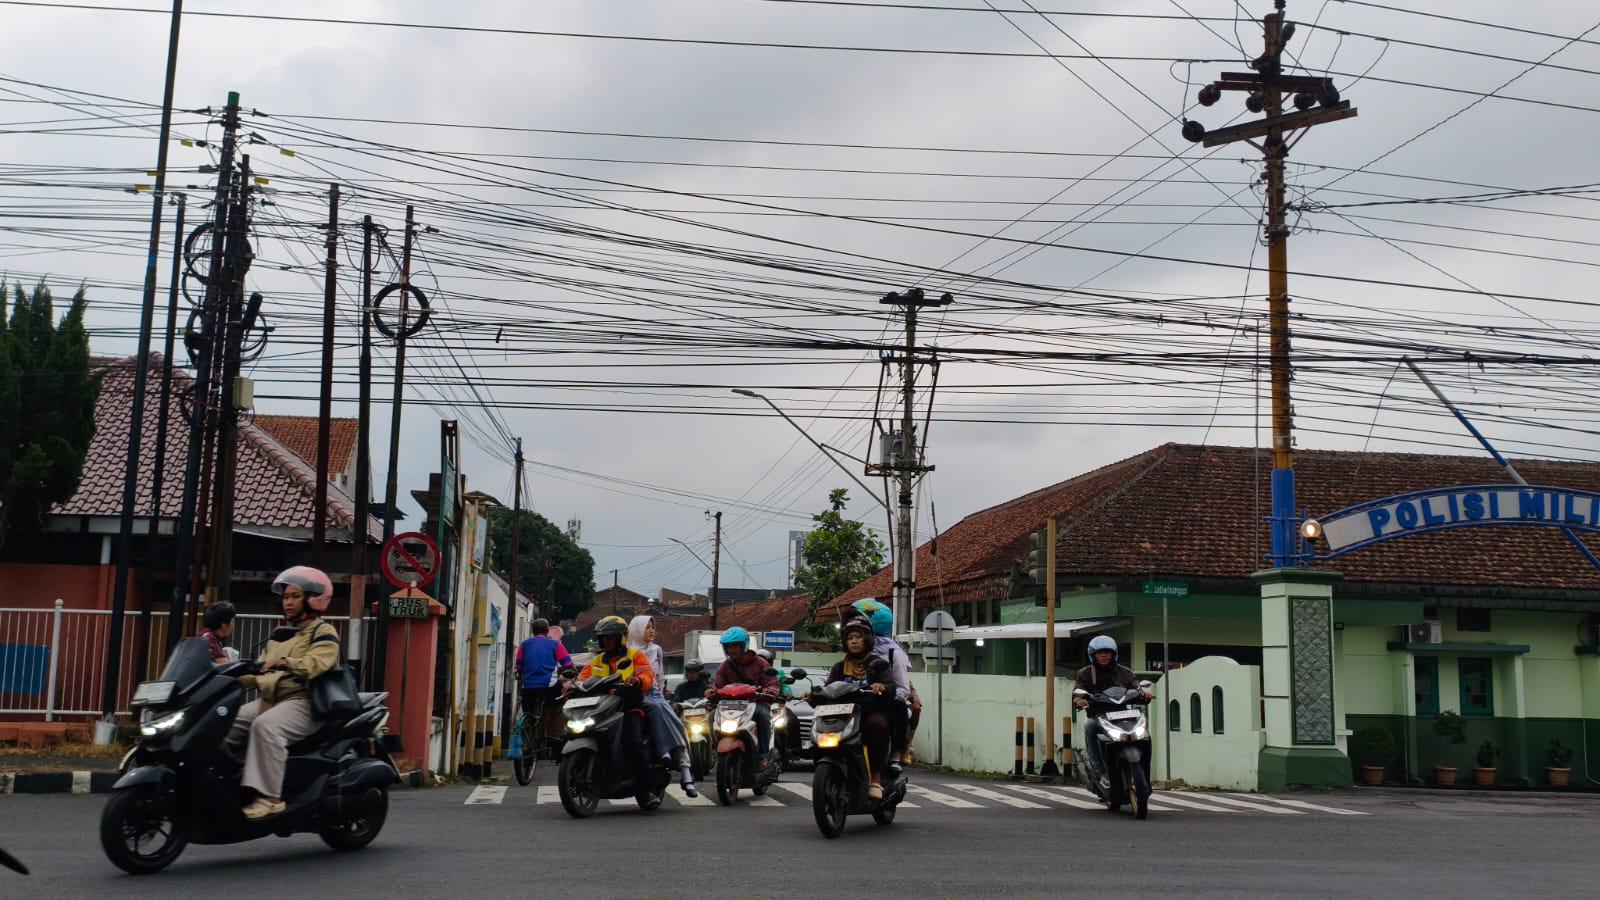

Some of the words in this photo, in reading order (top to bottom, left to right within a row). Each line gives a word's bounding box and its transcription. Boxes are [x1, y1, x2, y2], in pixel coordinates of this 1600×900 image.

[1368, 491, 1499, 537] POLISI
[397, 599, 422, 607] BUS
[392, 606, 425, 616] TRUK
